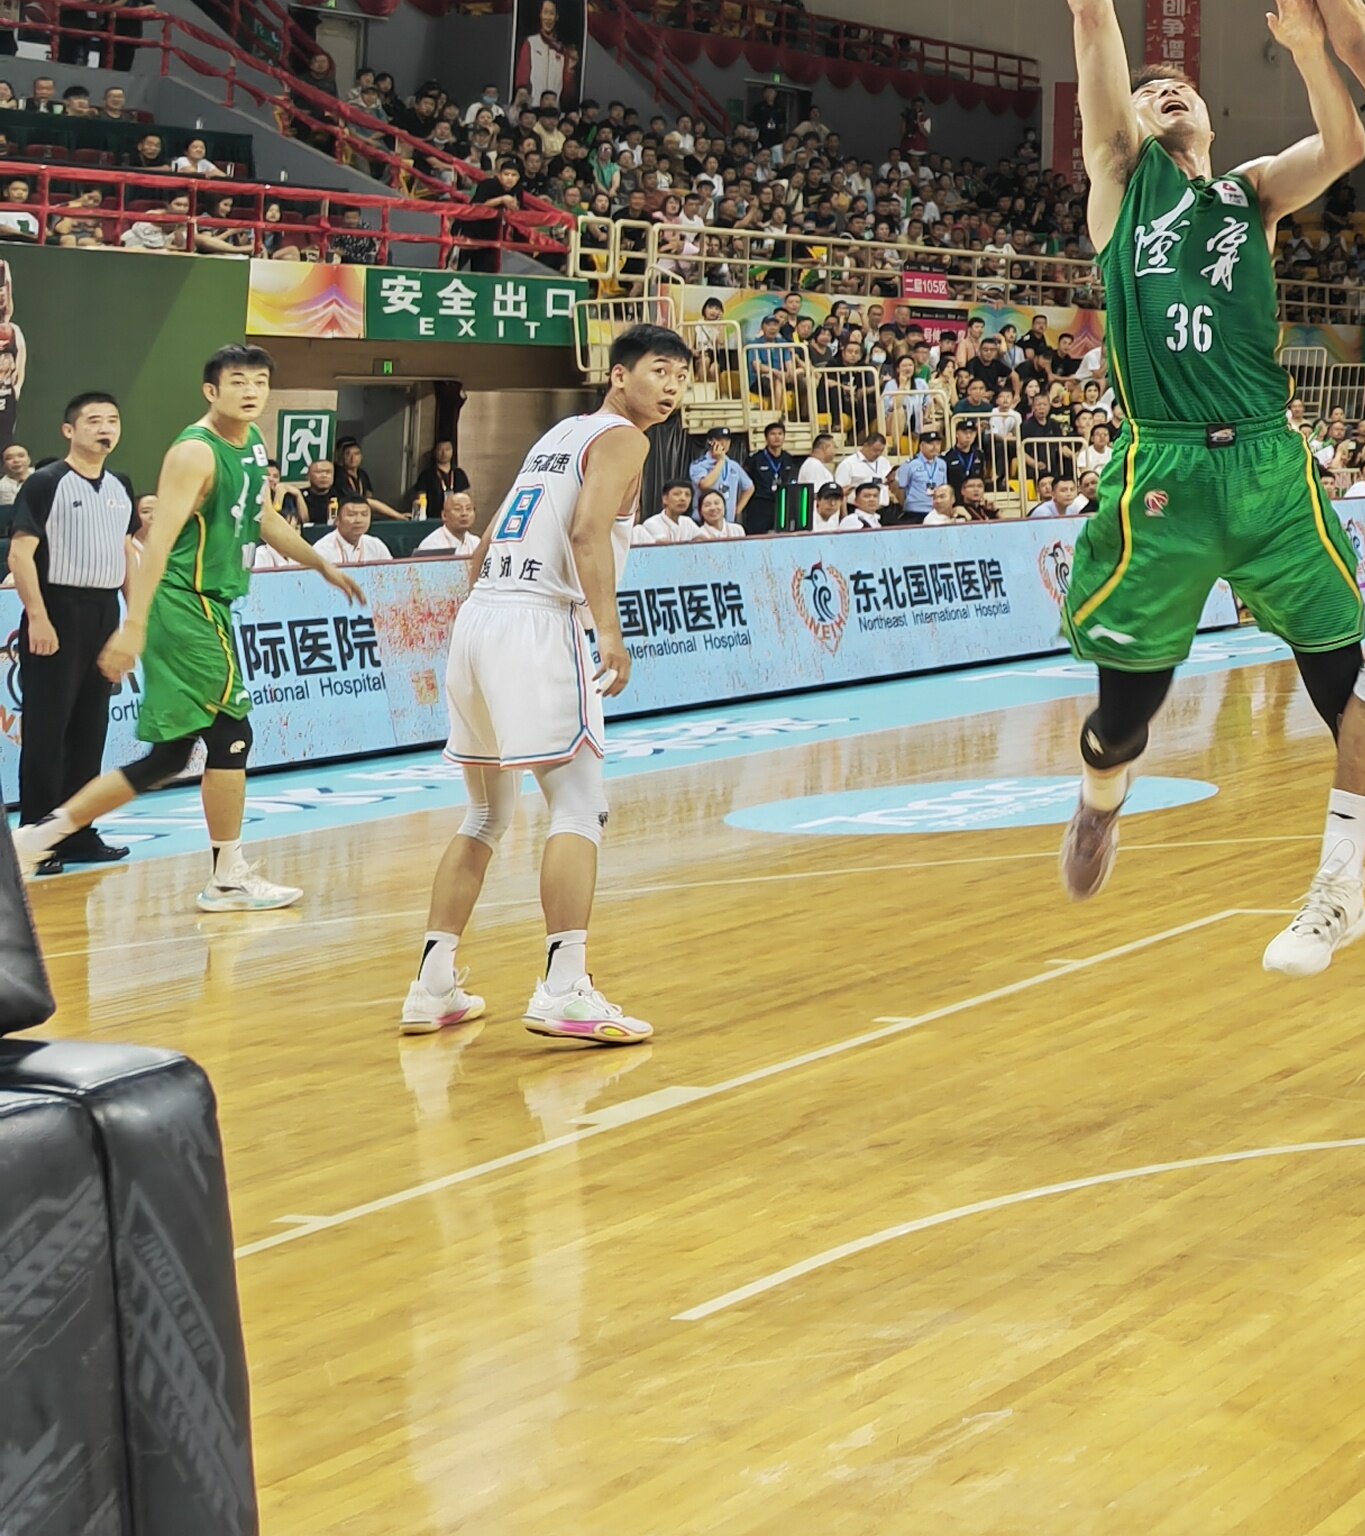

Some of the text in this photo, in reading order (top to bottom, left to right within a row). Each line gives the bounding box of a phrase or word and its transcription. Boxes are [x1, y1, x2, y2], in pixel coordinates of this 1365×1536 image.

[380, 275, 576, 319] 安全出口
[418, 317, 541, 338] EXIT
[1167, 303, 1213, 353] 36
[494, 485, 545, 543] 8
[849, 558, 1007, 614] 东北国际医院
[859, 599, 1012, 633] Northeast International Hospital
[704, 629, 752, 653] Hospital
[320, 672, 386, 701] Hospital
